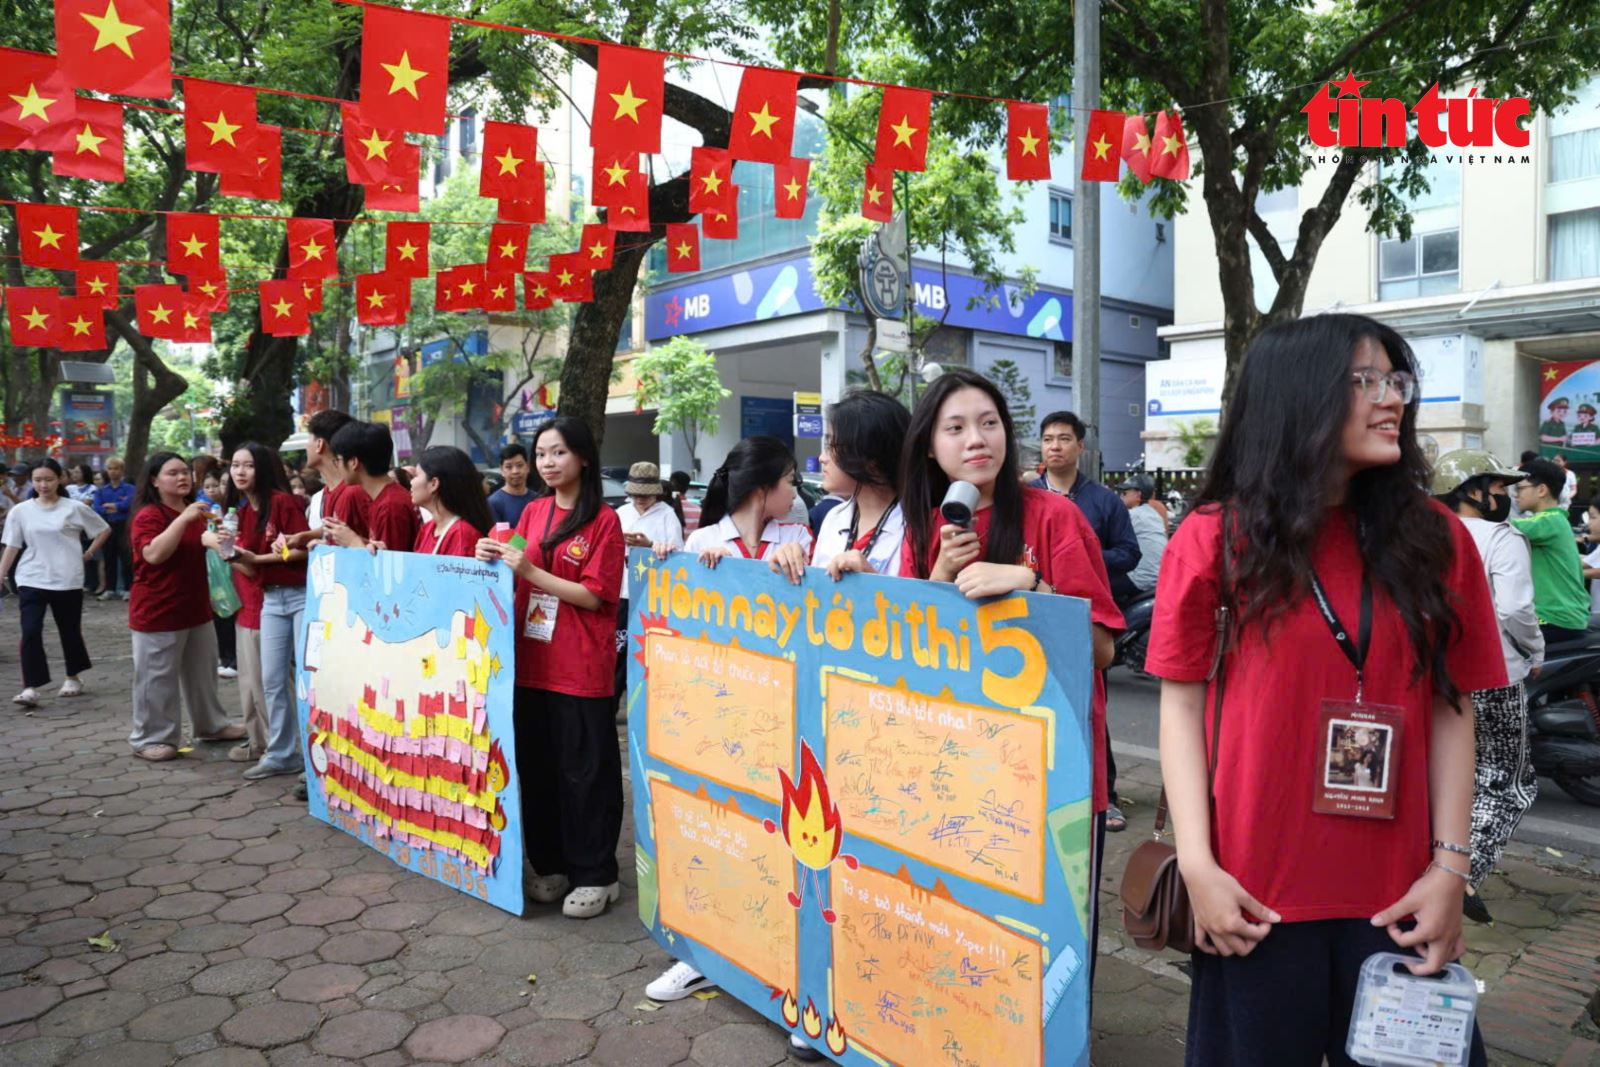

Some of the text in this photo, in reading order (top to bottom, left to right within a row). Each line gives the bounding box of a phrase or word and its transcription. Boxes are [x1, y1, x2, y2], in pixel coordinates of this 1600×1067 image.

[684, 294, 710, 320] MB
[913, 281, 945, 310] MB
[647, 567, 1048, 708] Hôm nay tớ đi thi 5
